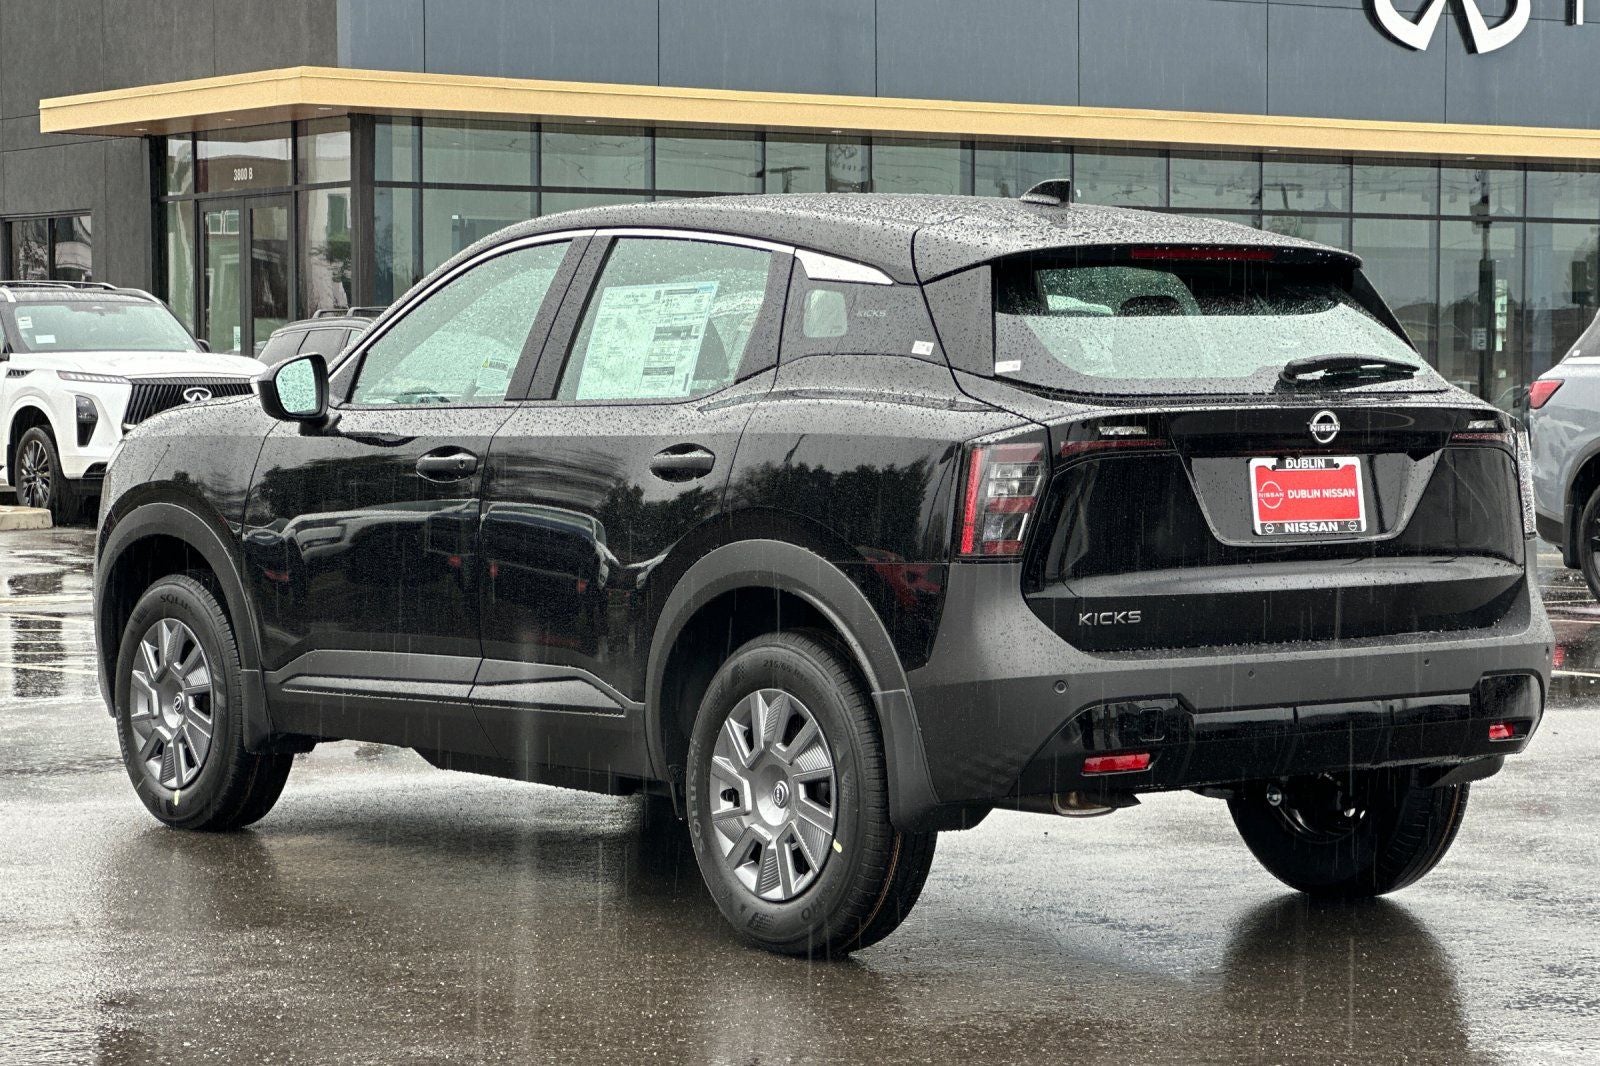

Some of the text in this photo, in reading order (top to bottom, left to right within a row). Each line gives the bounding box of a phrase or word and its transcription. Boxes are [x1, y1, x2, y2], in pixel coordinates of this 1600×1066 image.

[857, 309, 886, 318] KICKS
[1309, 423, 1341, 432] NISSAN
[1285, 458, 1326, 469] DUBLIN
[1287, 488, 1355, 499] DUBLIN NISSAN
[1284, 521, 1339, 533] NISSAN
[1078, 610, 1142, 626] KICKS
